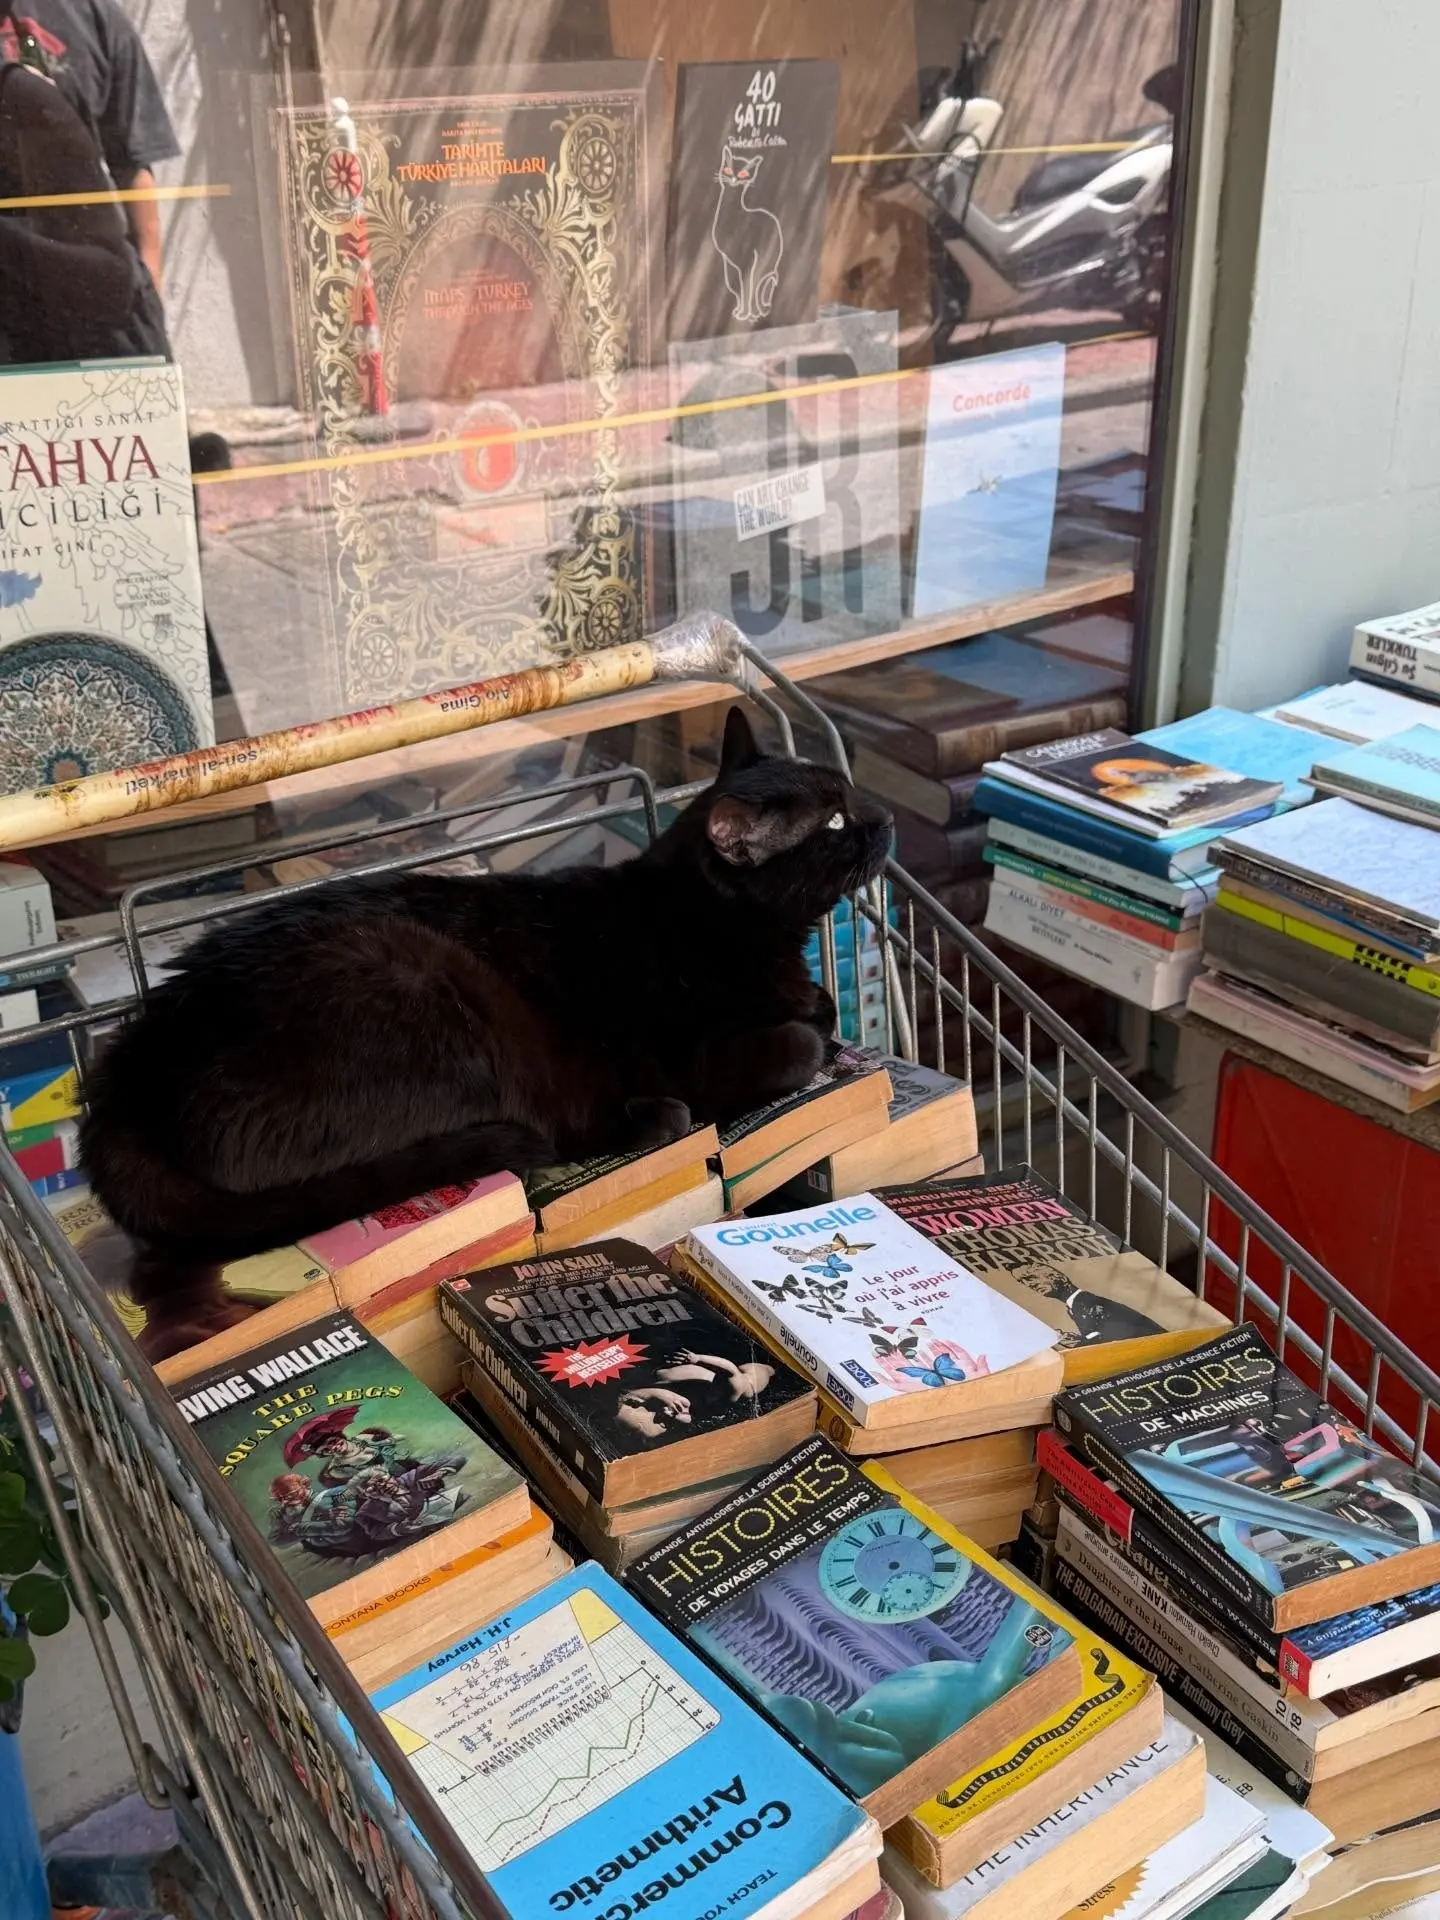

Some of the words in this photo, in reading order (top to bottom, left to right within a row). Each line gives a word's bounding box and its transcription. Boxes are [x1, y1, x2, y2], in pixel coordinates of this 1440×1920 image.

[746, 70, 776, 103] 40
[735, 102, 781, 132] GATTI
[397, 160, 456, 183] TÜRKİYE
[476, 281, 532, 299] TURKEY
[953, 381, 1031, 413] Concorde
[95, 411, 156, 427] SANAT
[440, 694, 481, 713] Gima
[886, 1188, 984, 1205] MARQUAND'S
[716, 1206, 877, 1246] Gounelle
[905, 1199, 1073, 1237] WOMEN
[932, 1217, 1098, 1254] THOMAS
[945, 1224, 977, 1235] AND
[512, 1258, 567, 1282] JOHN
[566, 1253, 613, 1271] SAUL
[952, 1235, 1120, 1273] HARROW
[854, 1288, 878, 1304] où
[880, 1281, 906, 1302] j'ai
[908, 1269, 959, 1294] appris
[861, 1273, 885, 1287] Le
[887, 1264, 919, 1284] jour
[485, 1281, 605, 1323] Suffer
[604, 1273, 679, 1302] the
[896, 1298, 907, 1312] à
[908, 1289, 950, 1308] vivre
[920, 1304, 945, 1315] ROMAN
[510, 1298, 694, 1348] Children
[247, 1325, 369, 1388] WALLACE
[440, 1296, 469, 1346] Suffer
[485, 1345, 529, 1413] Children
[564, 1351, 585, 1364] THE
[576, 1352, 629, 1380] BESTSELLER
[779, 1325, 819, 1372] Gounelle
[1068, 1391, 1081, 1400] LA
[1081, 1381, 1115, 1396] GRANDE
[1115, 1365, 1162, 1386] ANTHOLOGIE
[1162, 1362, 1175, 1373] DE
[1175, 1357, 1187, 1368] LA
[1185, 1331, 1252, 1364] SCIENCE-FICTION
[845, 1360, 877, 1388] POCKET
[1079, 1346, 1277, 1423] HISTOIRES
[252, 1384, 319, 1419] THE
[1139, 1416, 1172, 1434] DE
[1172, 1390, 1270, 1425] MACHINES
[218, 1402, 316, 1478] SQUARE
[325, 1386, 404, 1407] PEGS
[635, 1560, 650, 1572] LA
[649, 1536, 685, 1564] GRANDE
[685, 1505, 735, 1540] ANTHOLOGIE
[733, 1494, 747, 1507] DE
[747, 1487, 760, 1499] LA
[757, 1462, 793, 1490] SCIENCE
[791, 1439, 823, 1466] FICTION
[646, 1452, 850, 1599] HISTOIRES
[688, 1595, 711, 1614] DE
[707, 1557, 770, 1598] VOYAGES
[768, 1533, 807, 1561] DANS
[806, 1519, 828, 1536] LE
[825, 1490, 871, 1523] TEMPS
[384, 1575, 432, 1603] BOOKS
[1133, 1530, 1187, 1579] Janwillem
[1190, 1576, 1210, 1597] van
[1225, 1604, 1278, 1657] Wetering
[1140, 1580, 1170, 1615] KANE
[482, 1616, 514, 1639] J.H.
[427, 1636, 483, 1673] Harvey
[1055, 1561, 1074, 1588] THE
[1072, 1574, 1130, 1637] BULGARIAN
[1124, 1624, 1181, 1682] EXCLUSIVE
[1179, 1675, 1222, 1726] Anthony
[1219, 1710, 1246, 1746] Grey
[1078, 1552, 1121, 1598] Daughter
[1123, 1593, 1134, 1607] of
[1134, 1603, 1151, 1623] the
[1152, 1618, 1185, 1654] House
[1187, 1653, 1239, 1705] Catherine
[1240, 1702, 1281, 1744] Gaskin
[1275, 1699, 1287, 1719] 10
[1289, 1712, 1302, 1732] 18
[548, 1774, 748, 1912] Arithmetic
[726, 1868, 779, 1905] TEACH
[1077, 1882, 1117, 1912] Stress
